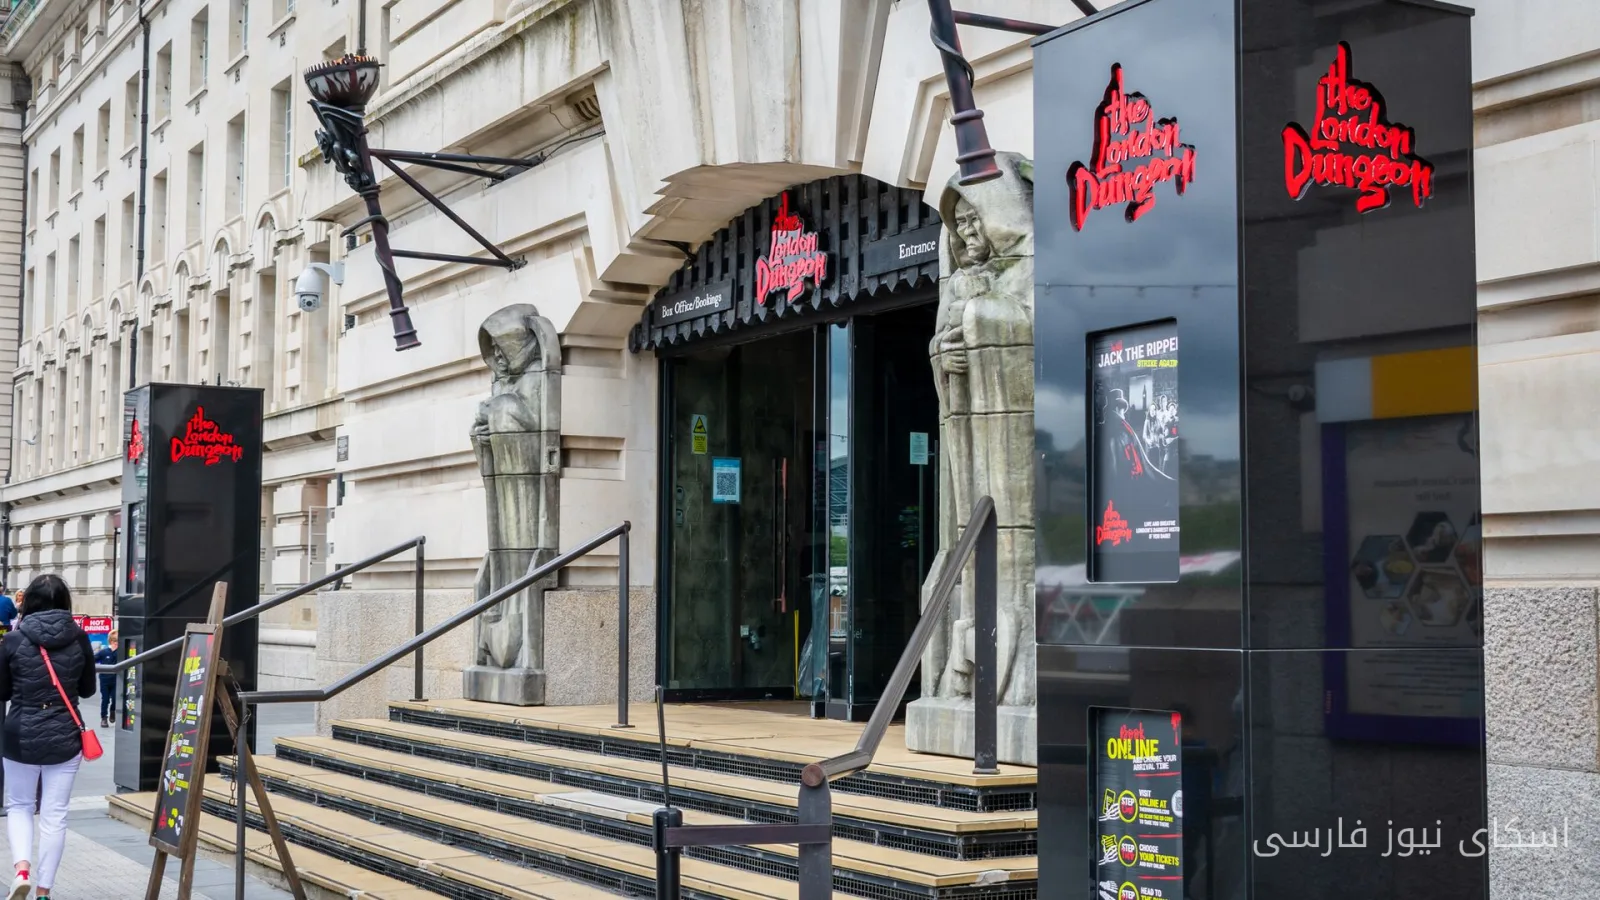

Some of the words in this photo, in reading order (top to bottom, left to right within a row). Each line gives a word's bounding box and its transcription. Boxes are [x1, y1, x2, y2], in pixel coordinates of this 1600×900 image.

[1318, 40, 1372, 115] the
[1103, 64, 1149, 134] the
[1308, 84, 1411, 158] London
[1096, 106, 1181, 178] London
[1280, 122, 1433, 214] Dungeon
[1070, 147, 1198, 231] Dungeon
[774, 191, 801, 235] the
[769, 223, 818, 268] London
[899, 239, 936, 259] Entrance
[756, 253, 827, 305] Dungeon
[662, 305, 674, 318] Box
[674, 293, 722, 314] Office/Bookings
[1098, 349, 1123, 368] JACK
[1125, 344, 1145, 361] THE
[191, 406, 214, 431] the
[185, 422, 233, 445] London
[171, 437, 242, 466] Dungeon
[1107, 737, 1159, 760] ONLINE
[1122, 797, 1134, 806] STEP
[1139, 789, 1152, 797] VISIT
[1139, 798, 1159, 808] ONLINE
[1160, 800, 1167, 808] AT
[1122, 843, 1135, 852] STEP
[1139, 844, 1159, 853] CHOOSE
[1139, 852, 1155, 862] YOUR
[1155, 854, 1180, 866] TICKETS
[1122, 890, 1135, 900] STEP
[1140, 887, 1154, 896] HEAD
[1154, 889, 1162, 897] TO
